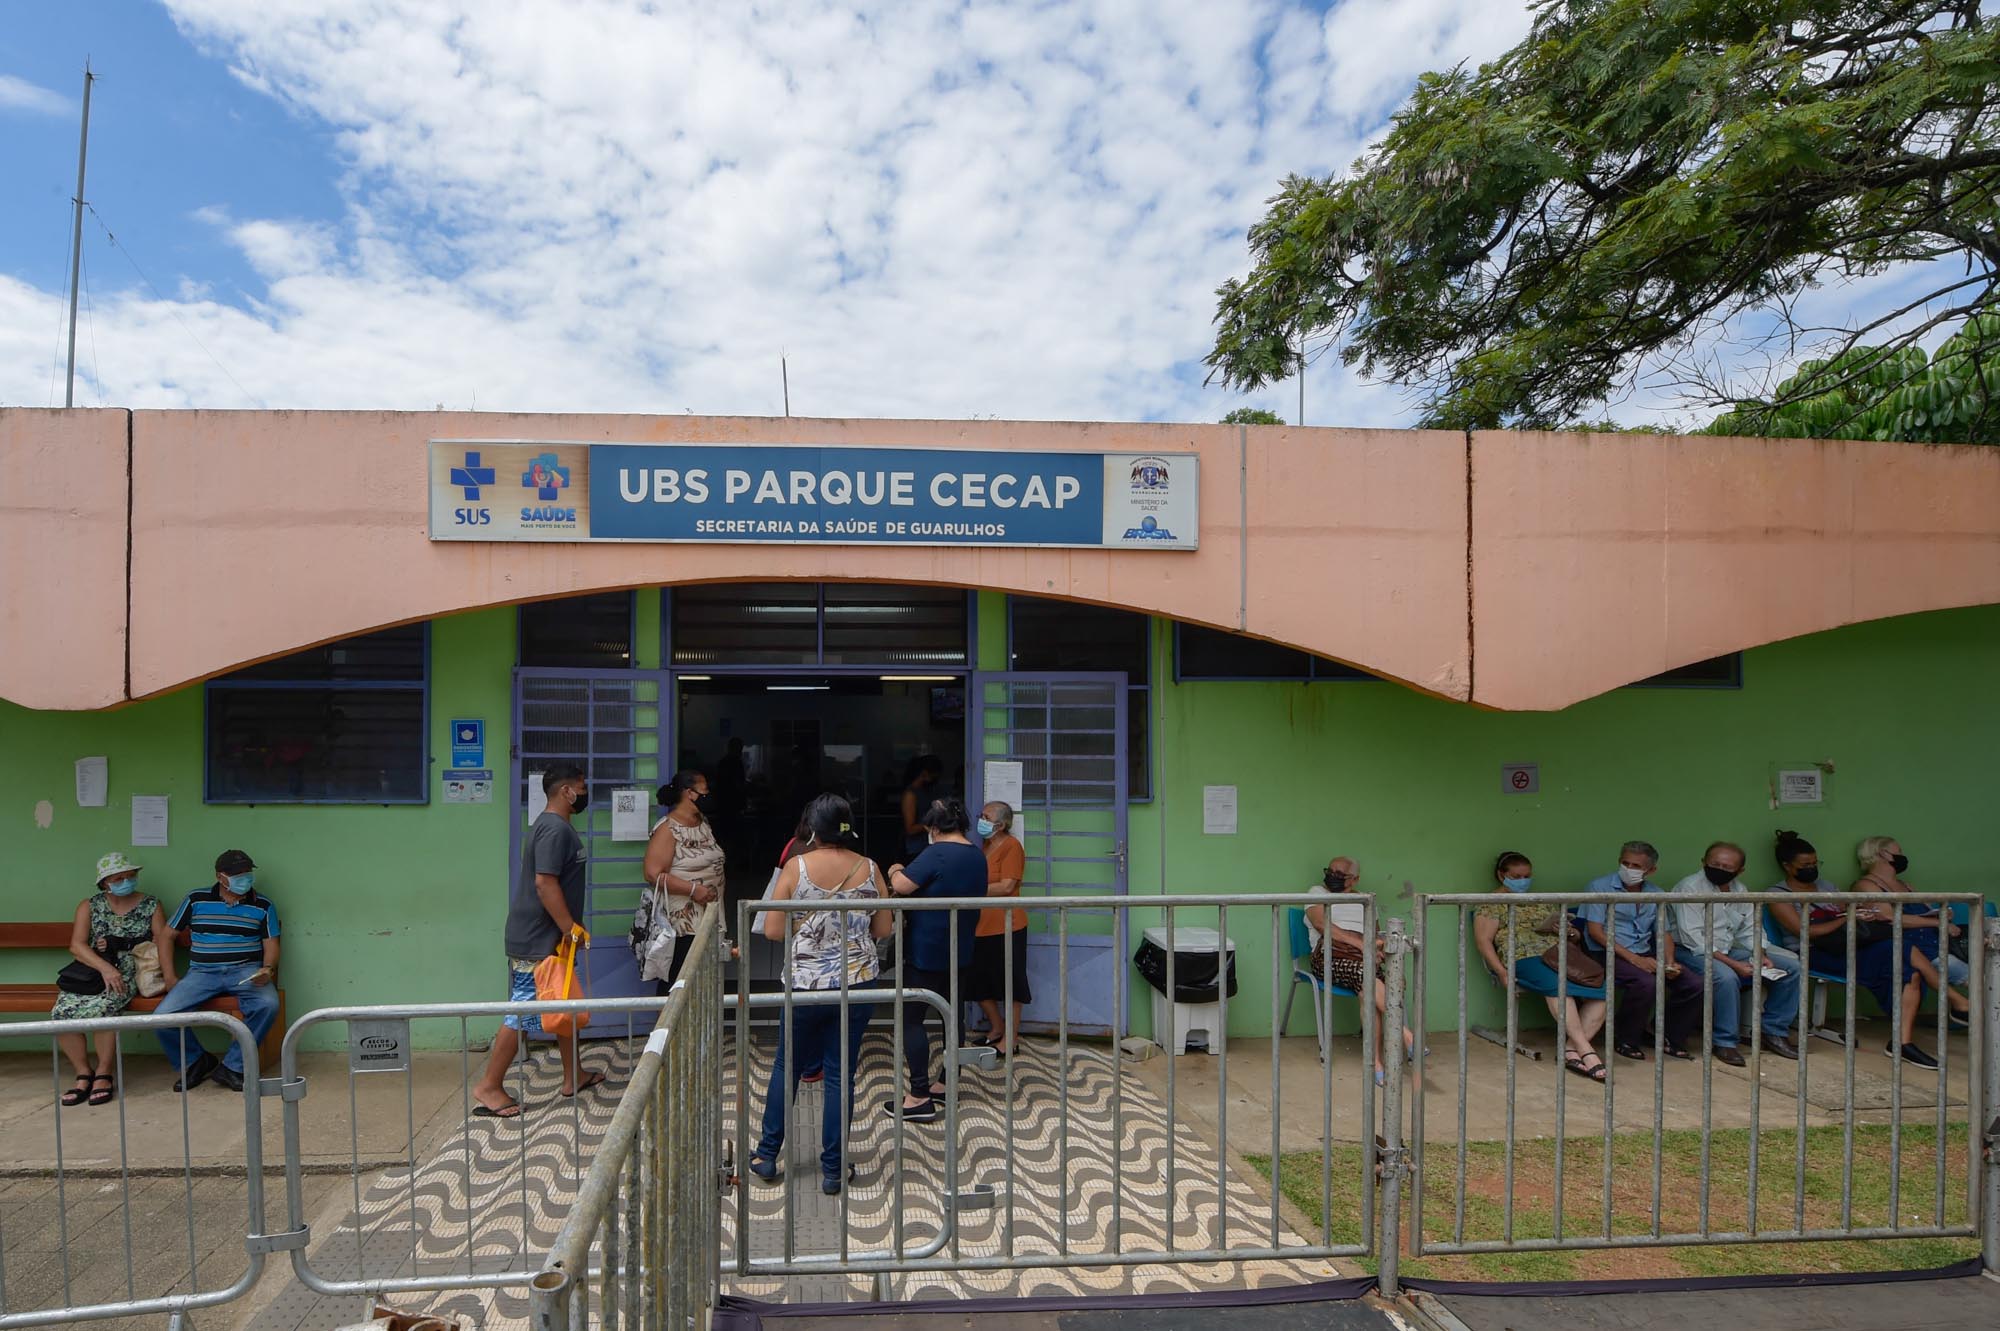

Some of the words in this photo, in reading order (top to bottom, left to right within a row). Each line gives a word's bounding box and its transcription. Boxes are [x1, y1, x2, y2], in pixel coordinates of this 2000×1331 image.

[619, 468, 709, 503] UBS
[725, 470, 914, 505] PARQUE
[929, 472, 1081, 509] CECAP
[454, 508, 491, 526] SUS
[520, 505, 577, 522] SAÚDE
[695, 519, 794, 534] SECRETARIA
[798, 520, 820, 534] DA
[825, 517, 878, 535] SAÚDE
[886, 521, 906, 535] DE
[910, 522, 1006, 537] GUARULHOS
[1122, 528, 1178, 540] BRASIL
